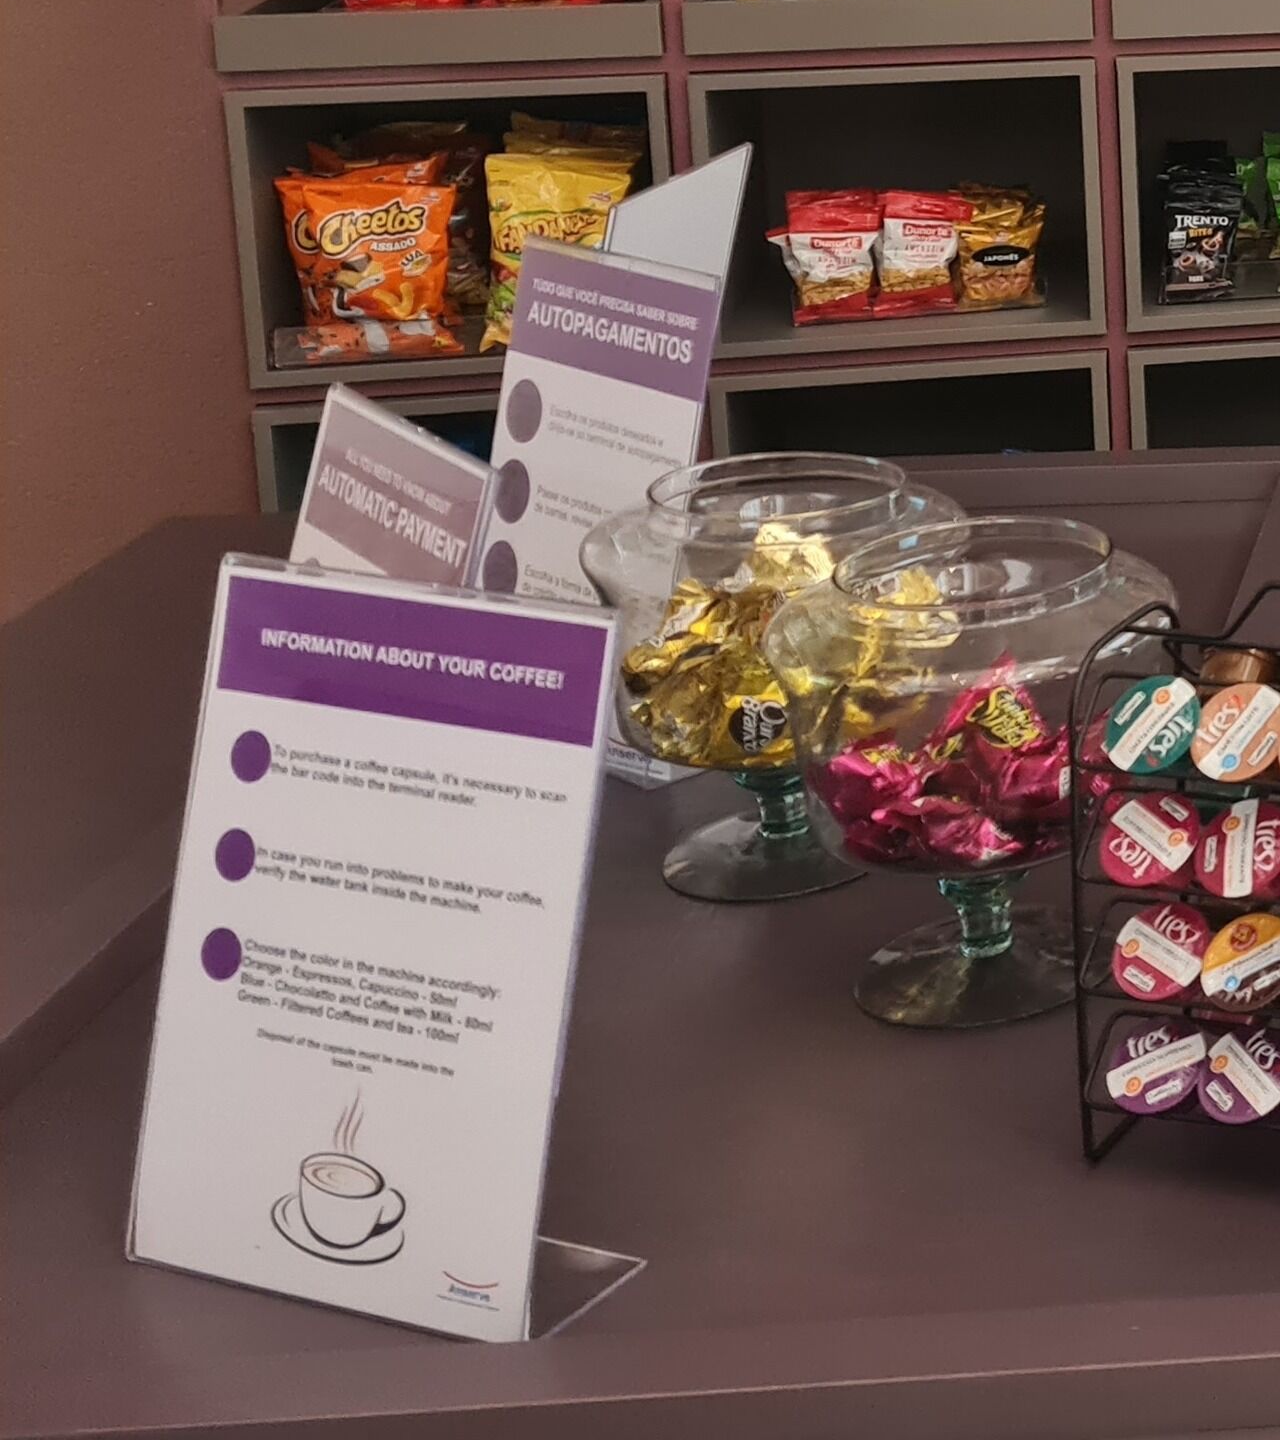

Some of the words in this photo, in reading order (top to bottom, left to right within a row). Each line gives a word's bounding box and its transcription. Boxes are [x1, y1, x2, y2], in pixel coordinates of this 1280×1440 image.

[319, 201, 426, 255] Cheetos
[1175, 214, 1228, 228] TRENTO
[1189, 227, 1213, 238] BITES
[370, 237, 417, 252] ASSADO
[400, 249, 424, 268] LUA
[575, 289, 598, 306] VOCÊ
[636, 303, 666, 322] SABER
[667, 311, 699, 331] SOBRE
[527, 300, 692, 364] AUTOPAGAMENTOS
[318, 464, 398, 528] AUTOMATIC
[395, 507, 468, 568] PAYMENT
[261, 628, 374, 661] INFORMATION
[376, 647, 432, 672] ABOUT
[437, 657, 486, 679] YOUR
[490, 664, 564, 690] COFFEE!
[272, 762, 288, 773] the
[291, 766, 309, 777] bar
[312, 771, 339, 783] code
[368, 778, 385, 790] the
[389, 782, 435, 798] terminal
[289, 750, 341, 767] purchase
[354, 760, 388, 773] coffee
[463, 778, 522, 799] necessary
[540, 791, 567, 802] scan
[271, 850, 296, 862] case
[300, 857, 320, 868] you
[372, 868, 424, 885] problems
[443, 880, 474, 893] make
[289, 870, 306, 882] the
[310, 876, 341, 888] water
[344, 879, 367, 892] tank
[372, 883, 406, 899] inside
[409, 891, 426, 903] the
[243, 956, 282, 975] Orange
[245, 939, 286, 957] Choose
[290, 949, 306, 961] the
[310, 954, 339, 967] color
[357, 961, 374, 974] the
[378, 966, 425, 983] machine
[238, 989, 270, 1005] Green
[241, 972, 264, 987] Blue
[364, 996, 399, 1014] Coffee
